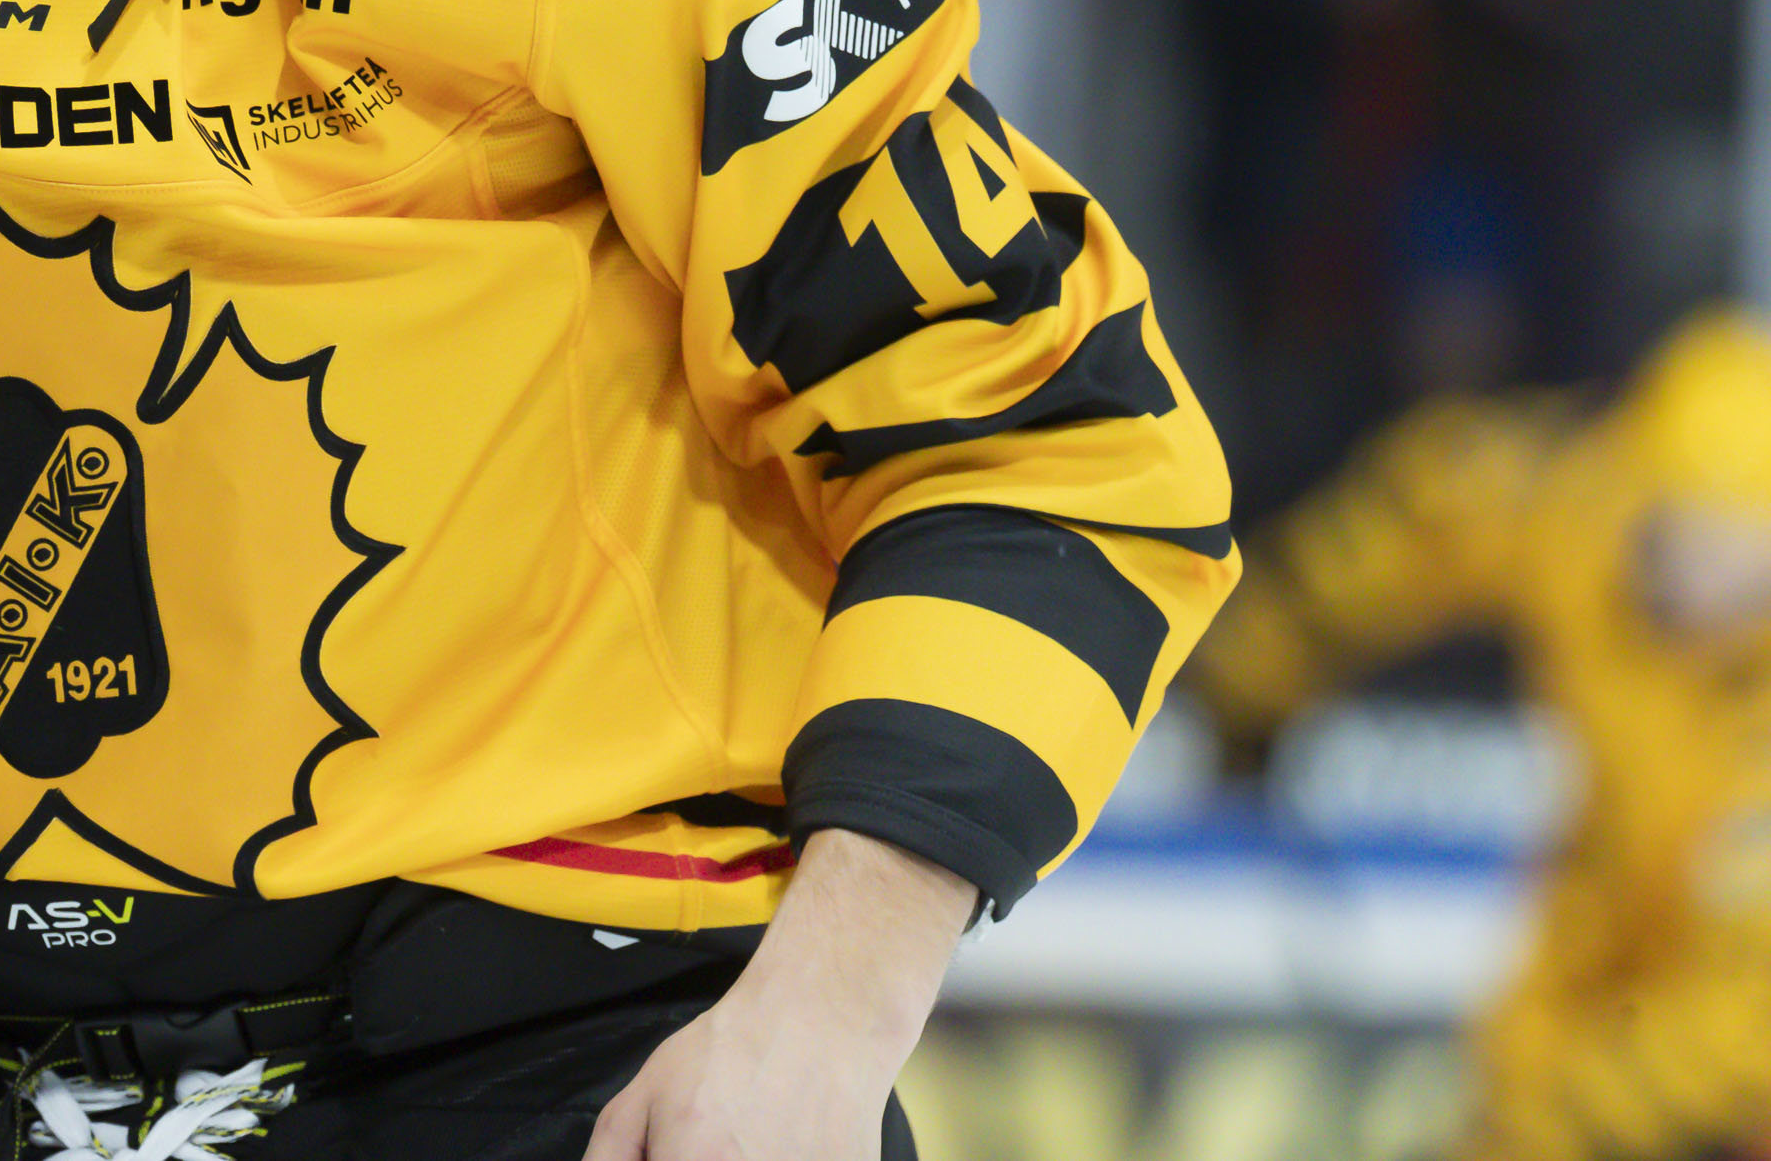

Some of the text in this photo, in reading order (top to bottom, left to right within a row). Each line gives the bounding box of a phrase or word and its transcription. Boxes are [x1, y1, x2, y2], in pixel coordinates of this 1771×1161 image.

[838, 95, 1050, 321] 14
[46, 654, 138, 704] 1921
[42, 929, 117, 949] PRO
